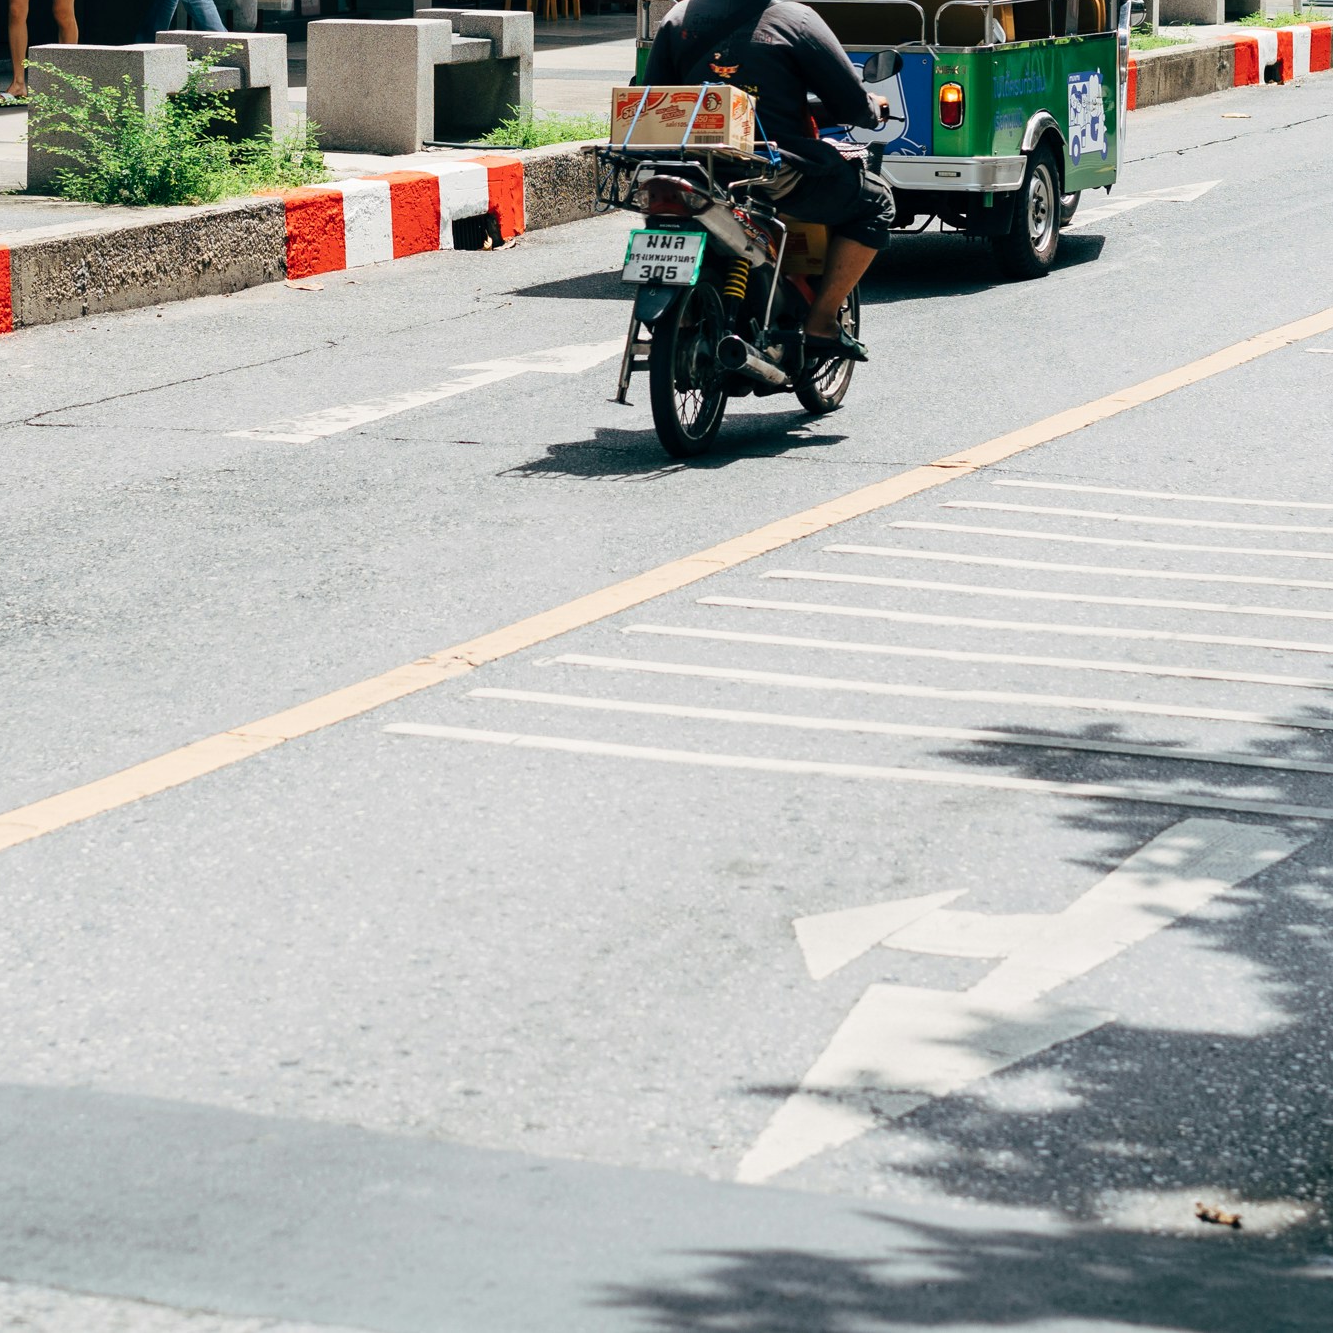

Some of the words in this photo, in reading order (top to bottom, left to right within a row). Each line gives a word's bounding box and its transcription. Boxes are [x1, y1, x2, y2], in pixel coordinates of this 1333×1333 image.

[646, 235, 685, 249] มมล
[629, 253, 696, 264] กรุงเทพมหานคร
[639, 265, 678, 280] 305
